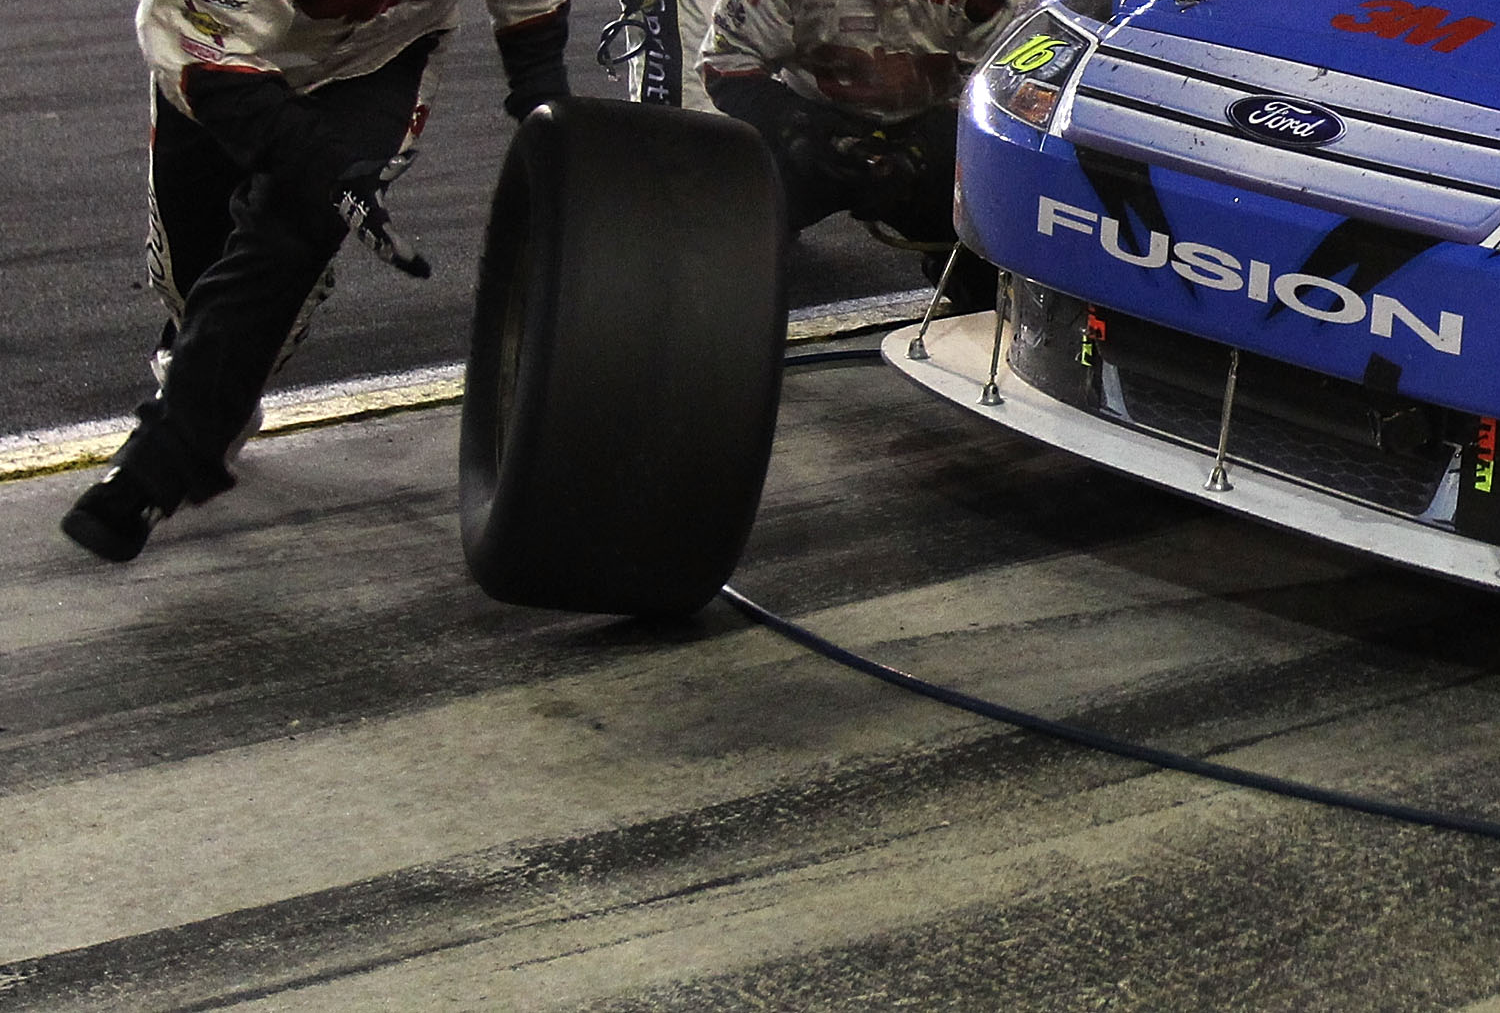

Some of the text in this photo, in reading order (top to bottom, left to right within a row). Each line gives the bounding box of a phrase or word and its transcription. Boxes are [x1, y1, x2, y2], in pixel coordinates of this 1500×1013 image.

[997, 35, 1070, 75] 16
[1248, 100, 1325, 138] Ford
[1037, 196, 1464, 356] FUSION
